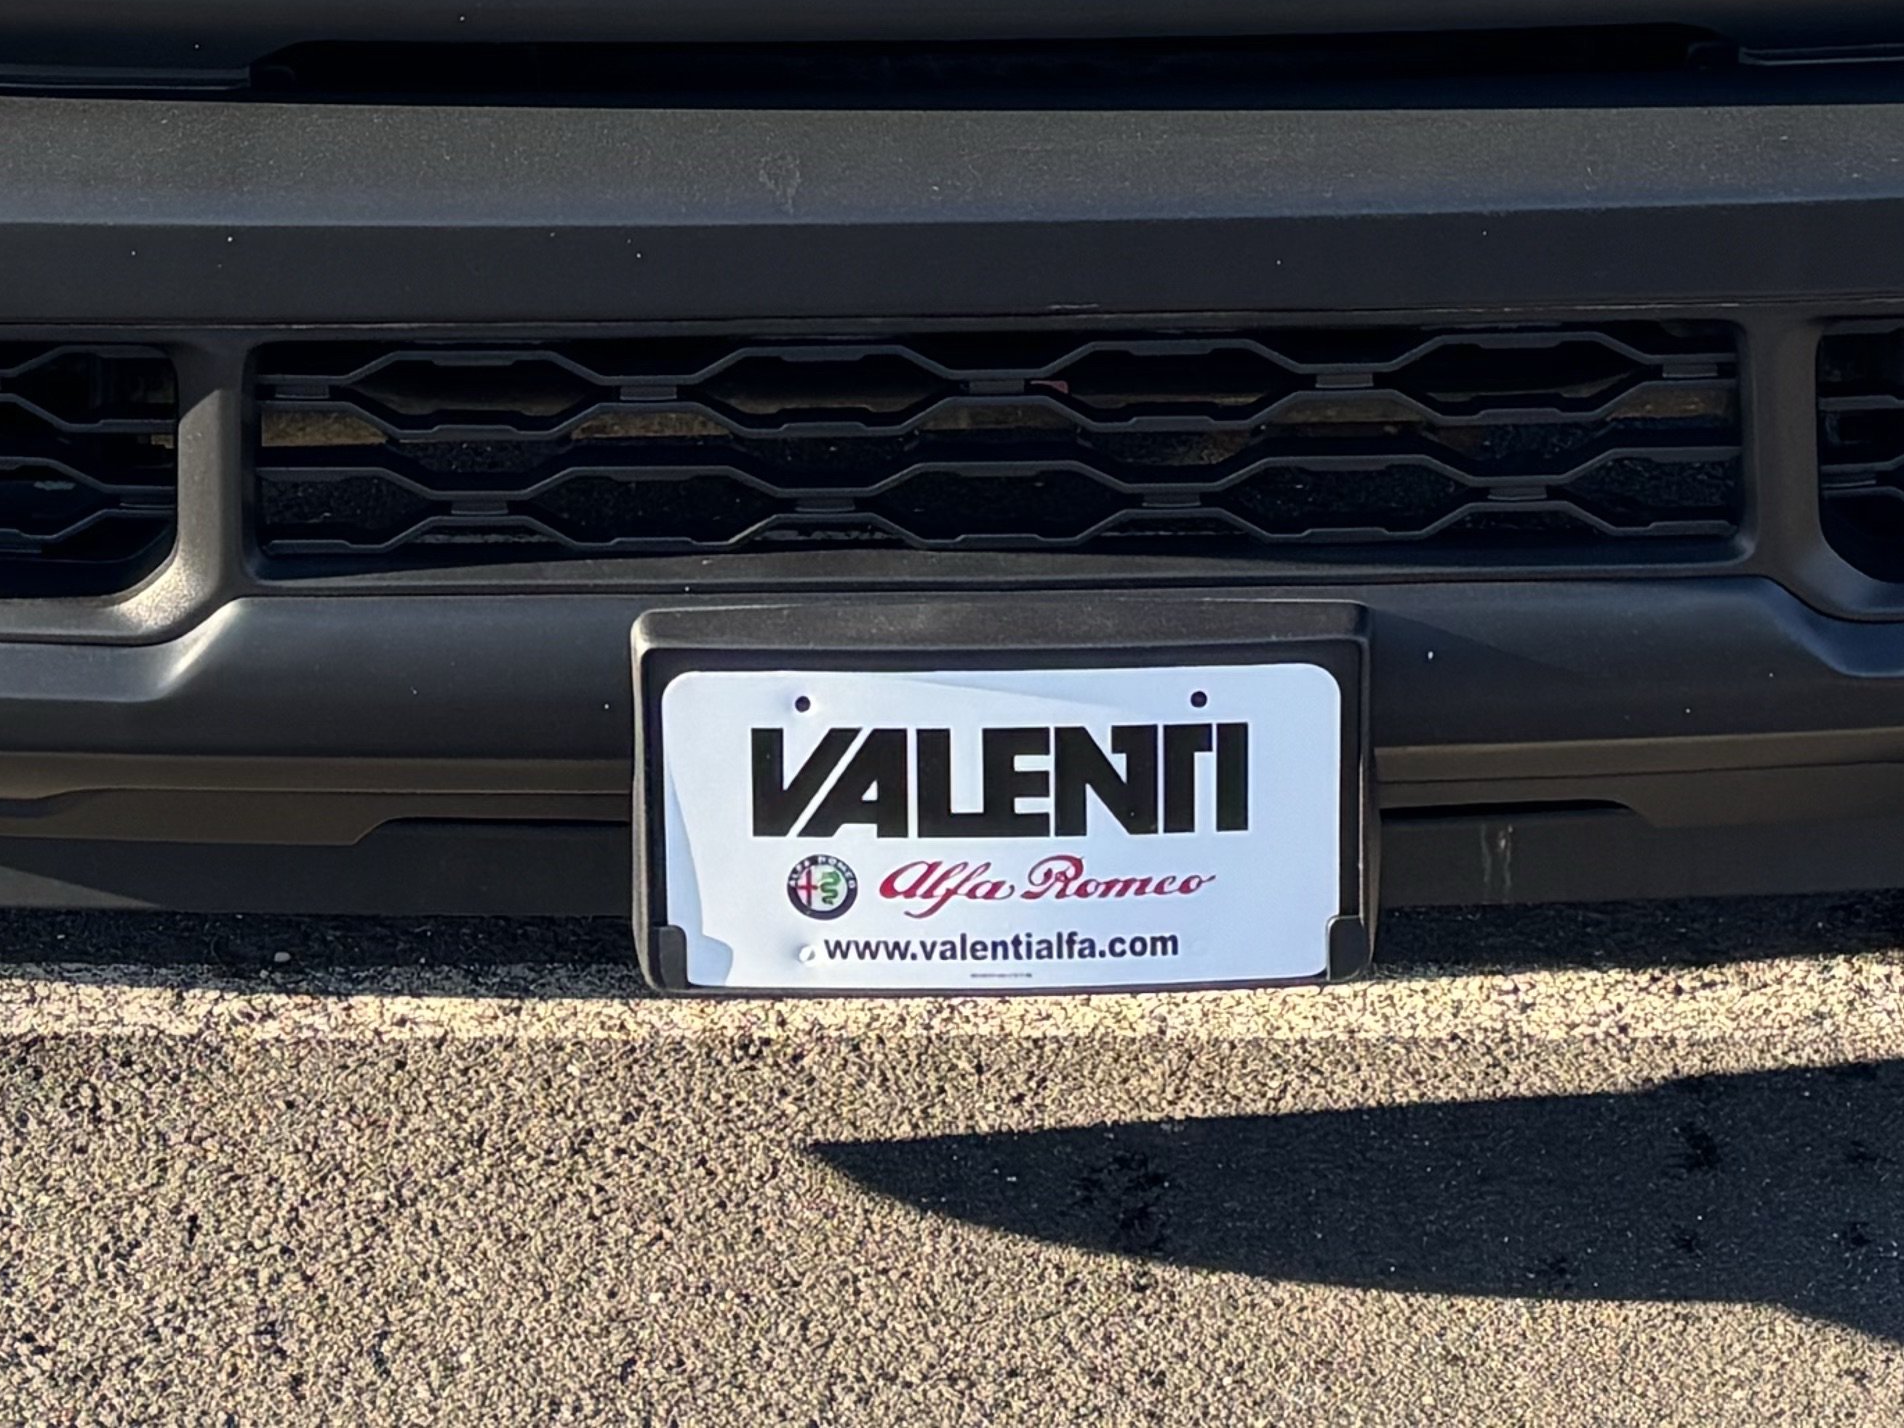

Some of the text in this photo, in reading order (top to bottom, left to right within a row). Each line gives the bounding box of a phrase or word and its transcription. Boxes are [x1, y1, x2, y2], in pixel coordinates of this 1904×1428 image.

[750, 722, 1249, 838] VALENTI
[879, 854, 1216, 919] Alfa Romeo
[823, 931, 1179, 961] www.valentialfa.com
